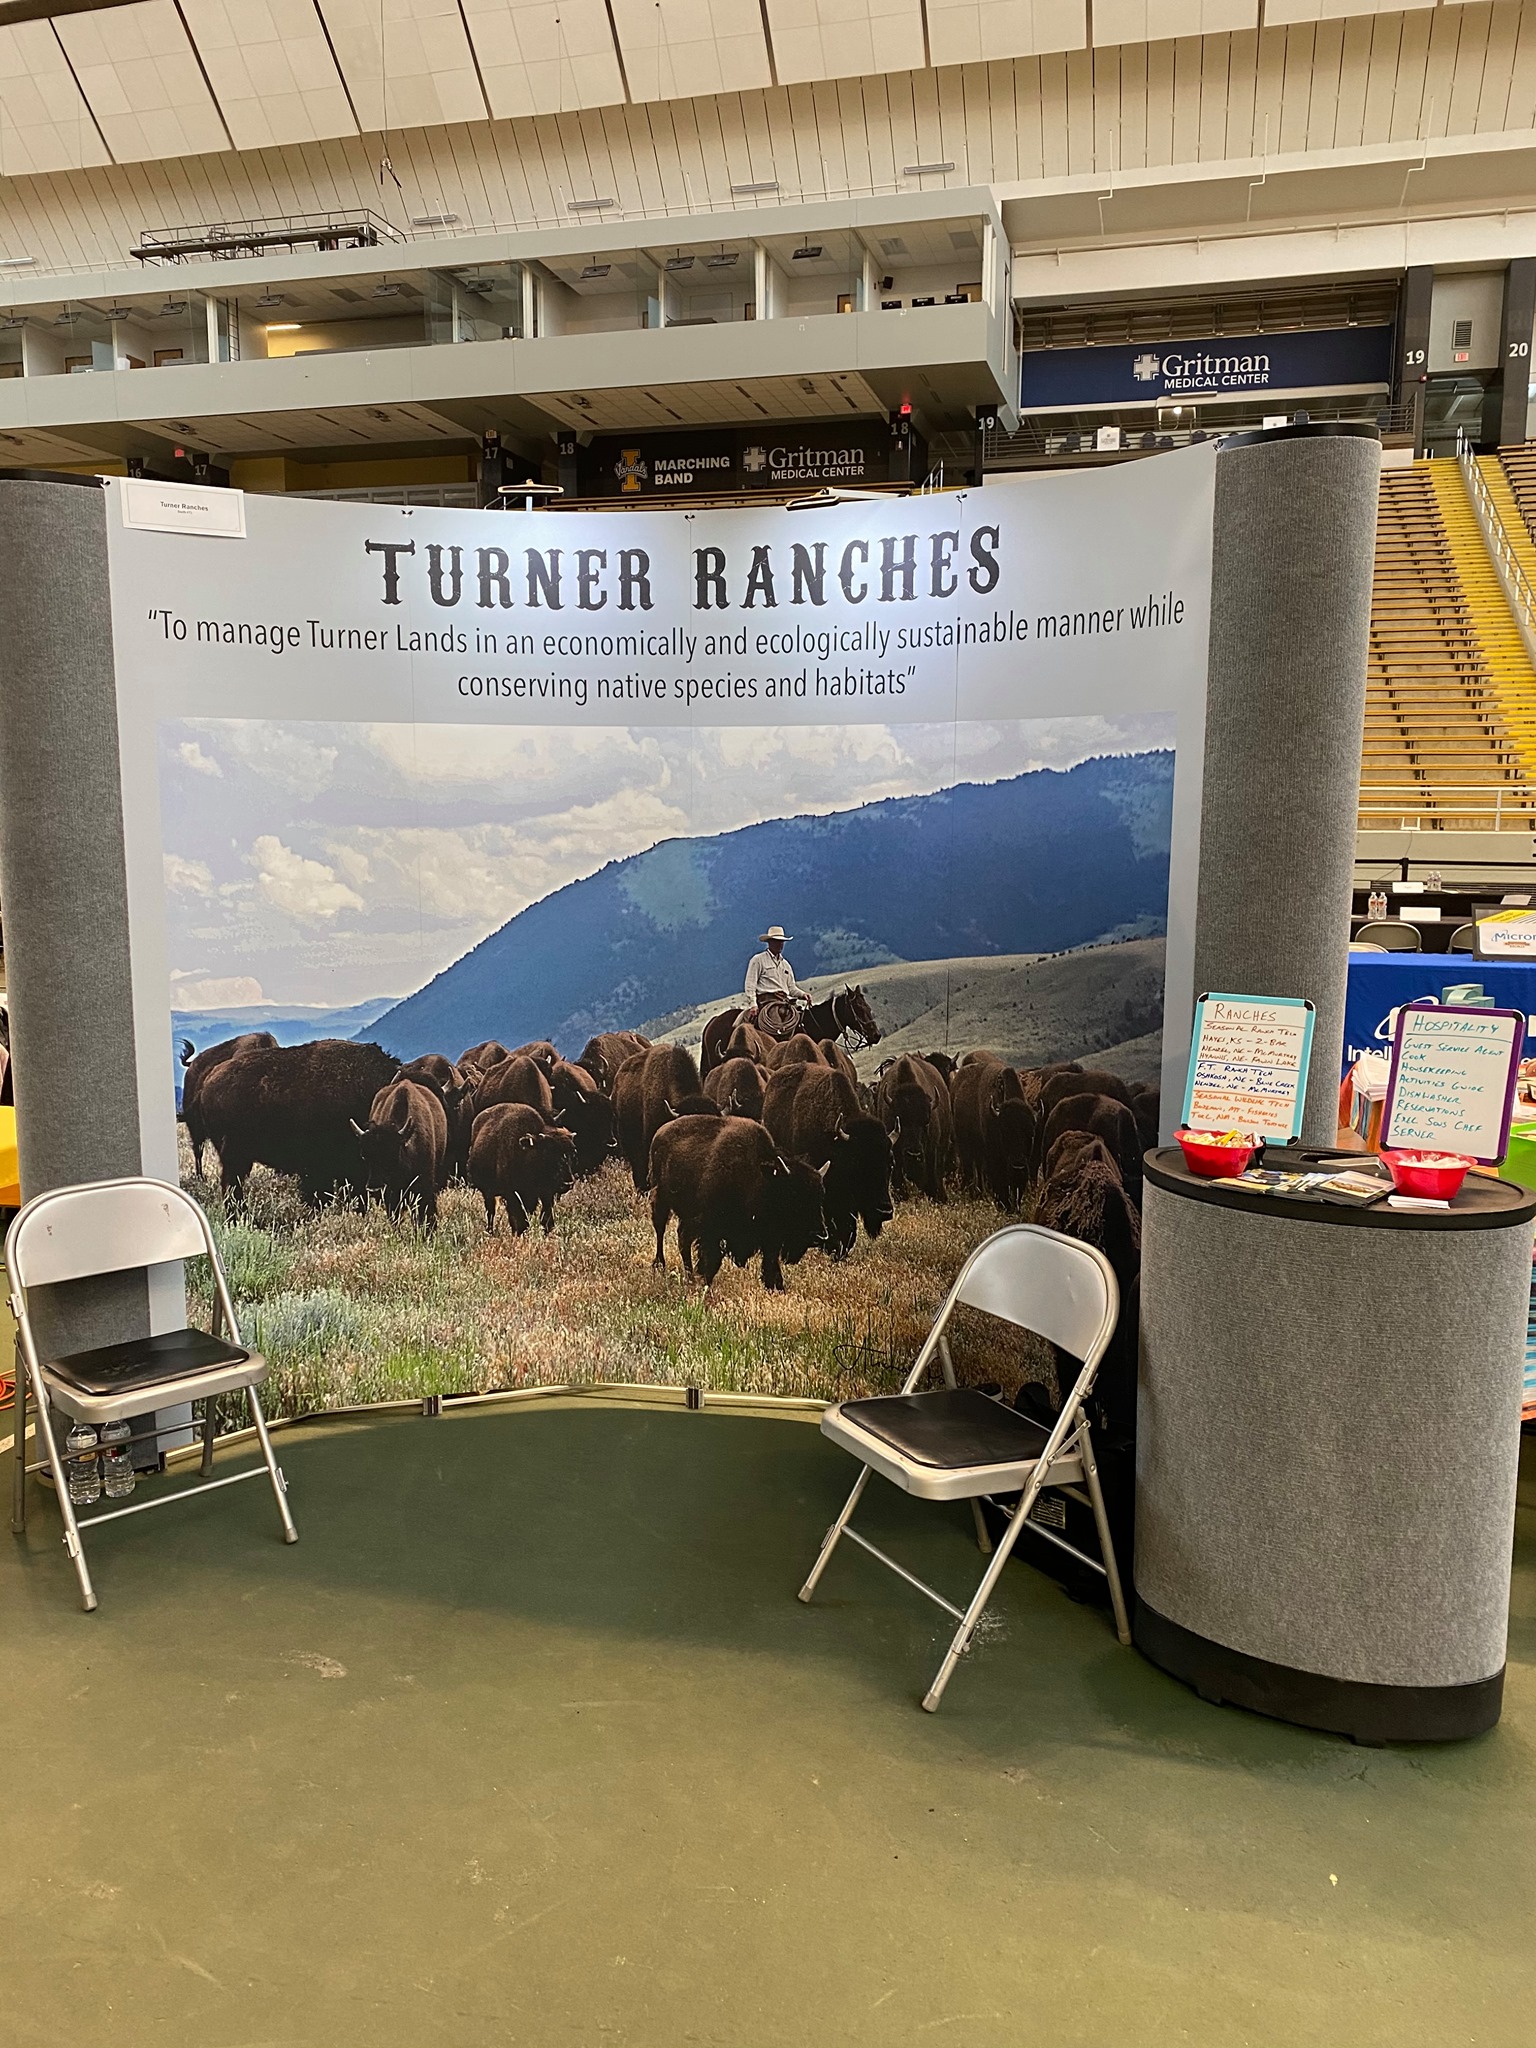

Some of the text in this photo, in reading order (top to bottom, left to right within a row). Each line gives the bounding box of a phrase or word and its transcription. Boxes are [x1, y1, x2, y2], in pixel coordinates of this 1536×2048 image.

[1406, 350, 1425, 365] 19
[1508, 342, 1529, 358] 20
[1162, 353, 1270, 377] Gritman
[1164, 373, 1269, 389] MEDICAL CENTER
[890, 422, 909, 436] 18
[978, 416, 995, 430] 19
[485, 447, 498, 460] 17
[559, 442, 575, 455] 18
[654, 456, 731, 471] MARCHING
[768, 446, 866, 468] Gritman
[195, 464, 207, 476] 17
[614, 459, 648, 479] Vandals
[771, 465, 865, 480] MEDICAL CENTER
[654, 472, 694, 485] BAND
[160, 501, 209, 511] Turner Ranches
[364, 524, 1001, 611] TURNER RANCHES
[196, 619, 301, 654] manage
[306, 619, 389, 650] Turner
[396, 624, 468, 653] Lands
[476, 627, 497, 654] in
[506, 634, 534, 655] an
[543, 627, 697, 663] economically
[704, 626, 747, 655] and
[756, 621, 891, 661] ecologically
[897, 610, 1028, 650] sustainable
[1036, 606, 1124, 639] manner
[1130, 591, 1185, 630] while
[458, 673, 587, 706] conserving
[597, 673, 667, 699] native
[674, 672, 758, 706] species
[765, 668, 806, 697] and
[1214, 1003, 1277, 1022] RANCHES
[1203, 1023, 1248, 1032] SEASONAL
[1412, 1013, 1499, 1034] HOSPITALITY
[1403, 1038, 1505, 1056] GUEST SERVICE AGENT
[1401, 1051, 1427, 1061] COOK
[1224, 1065, 1248, 1074] RANCH
[1250, 1068, 1273, 1077] TECH
[1401, 1062, 1468, 1076] HOUSEKEEPING
[1398, 1074, 1485, 1093] ACTIVITIES GUIDE
[1193, 1091, 1231, 1101] SEASONAL
[1398, 1086, 1462, 1105] DISHWASHER
[1396, 1099, 1466, 1117] RESERVATIONS
[1425, 1116, 1448, 1129] SOUS
[1454, 1121, 1483, 1132] CHEF
[1389, 1125, 1437, 1140] SERVER
